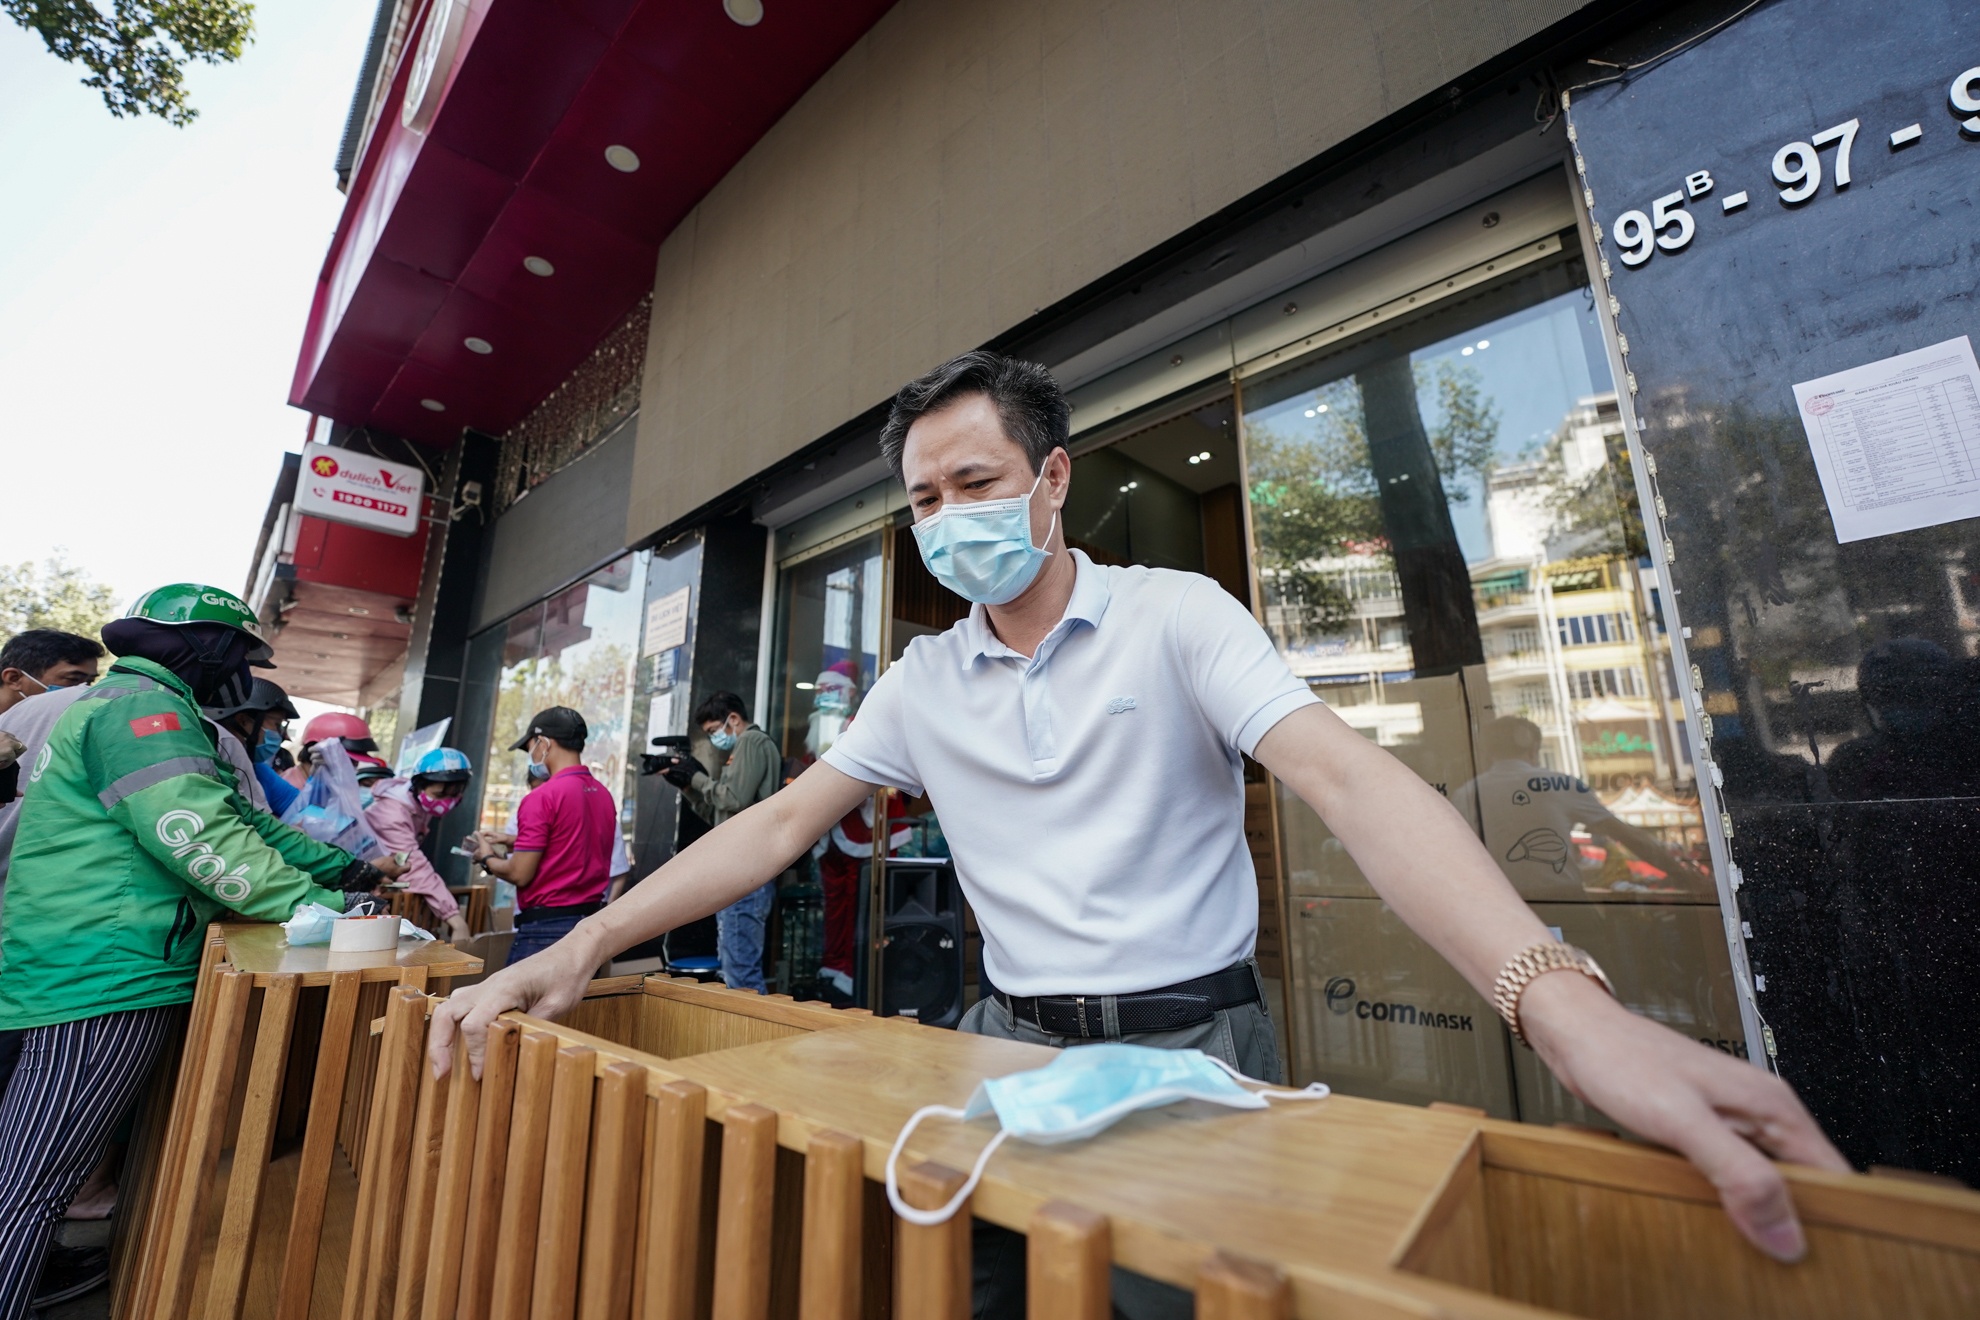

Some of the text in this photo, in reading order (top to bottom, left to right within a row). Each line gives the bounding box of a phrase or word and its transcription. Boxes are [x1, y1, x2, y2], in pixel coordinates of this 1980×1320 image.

[1771, 117, 1860, 204] 97
[201, 592, 250, 616] Grab
[1527, 775, 1570, 793] MED
[156, 808, 251, 902] Grab
[1419, 1010, 1473, 1031] MASK
